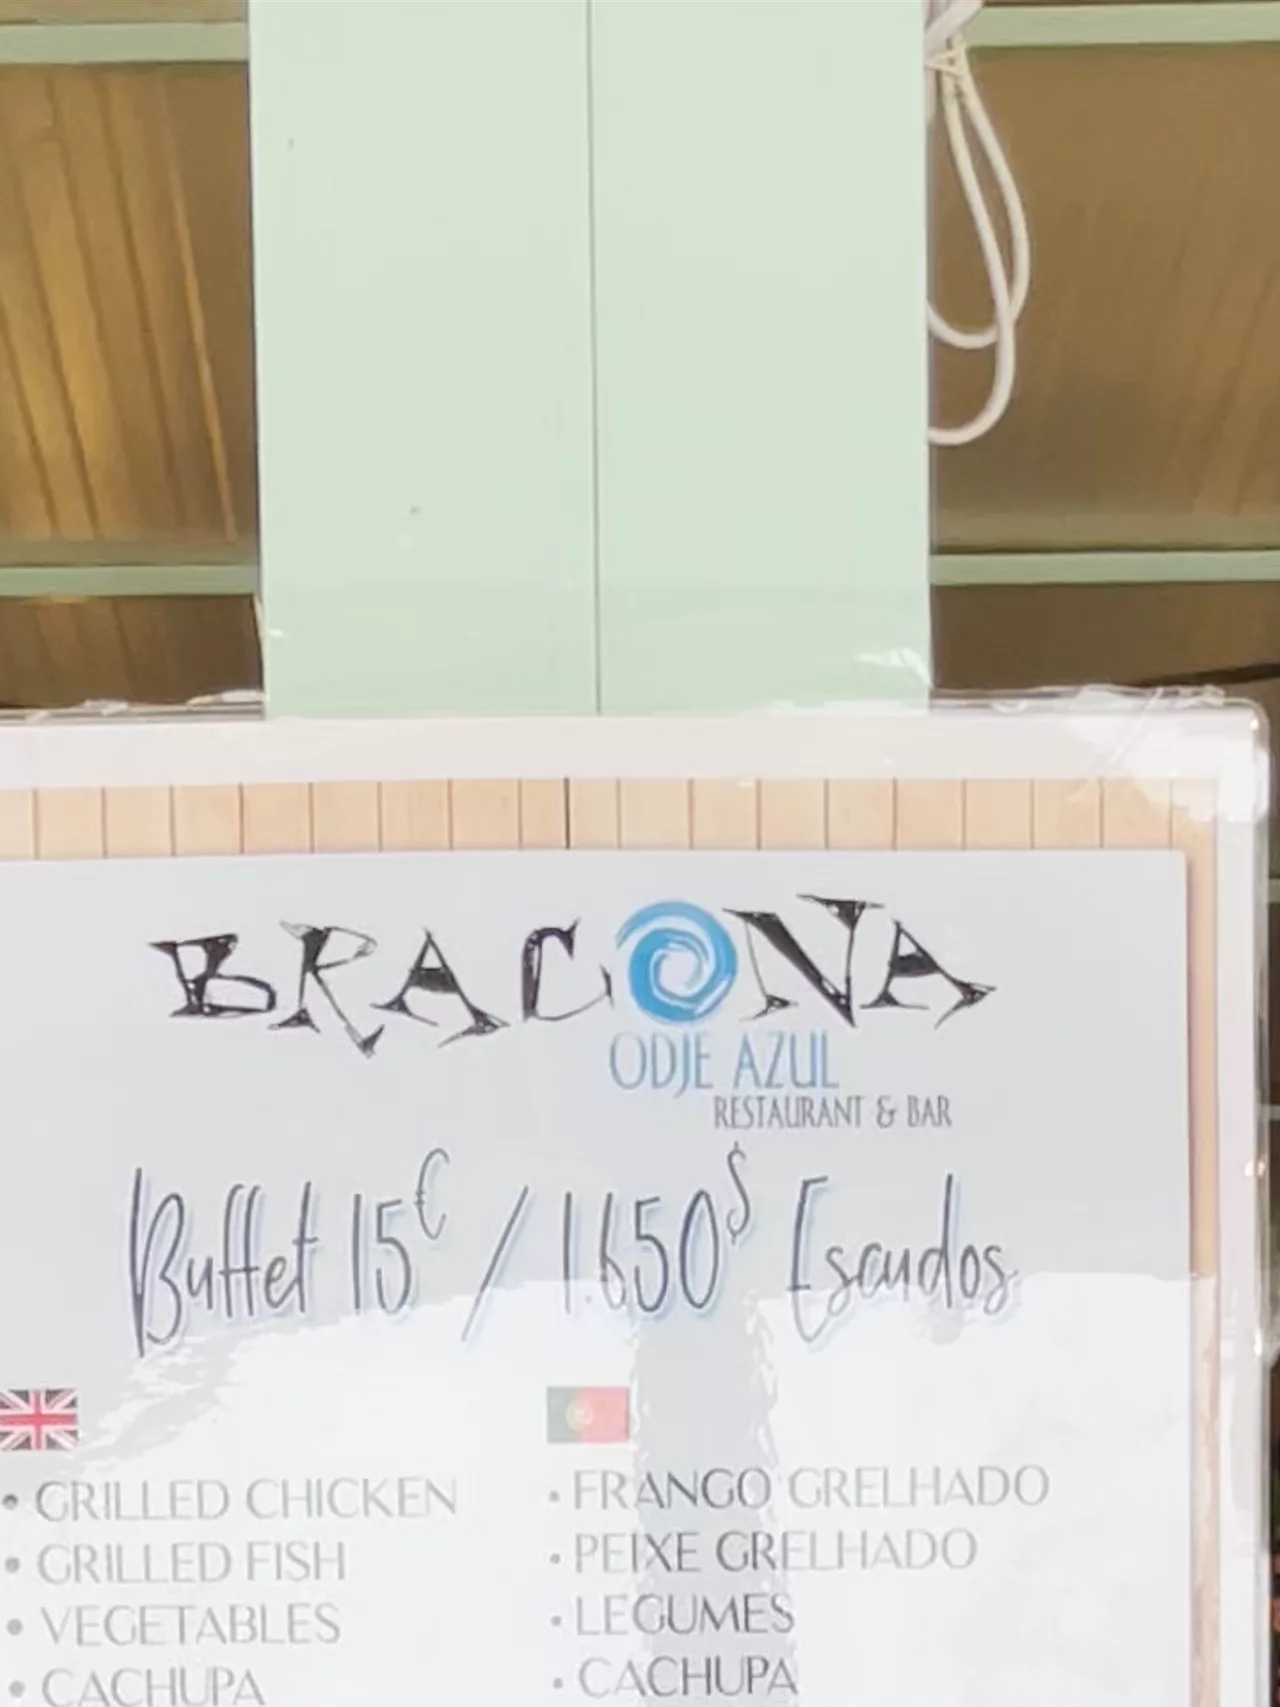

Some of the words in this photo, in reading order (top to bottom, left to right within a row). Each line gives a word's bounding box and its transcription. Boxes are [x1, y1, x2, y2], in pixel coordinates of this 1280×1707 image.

[146, 893, 998, 1056] BRACONA
[733, 1031, 839, 1089] AZUL
[714, 1096, 865, 1129] RESTAURANT
[875, 1096, 897, 1128] &
[907, 1096, 952, 1128] BAR
[130, 1167, 319, 1358] Buffet
[461, 1185, 530, 1341] /
[786, 1172, 1018, 1343] Escudos
[35, 1480, 230, 1522] GRILLED
[246, 1478, 457, 1519] CHICKEN
[573, 1468, 772, 1509] FRANGO
[787, 1465, 1050, 1508] GRELHADO
[36, 1542, 233, 1584] GRILLED
[246, 1540, 346, 1580] FISH
[575, 1532, 702, 1574] PEIXE
[716, 1528, 977, 1572] GRELHADO
[40, 1602, 342, 1647] VEGETABLES
[576, 1594, 795, 1635] LEGUMES
[577, 1655, 798, 1697] CACHUPA
